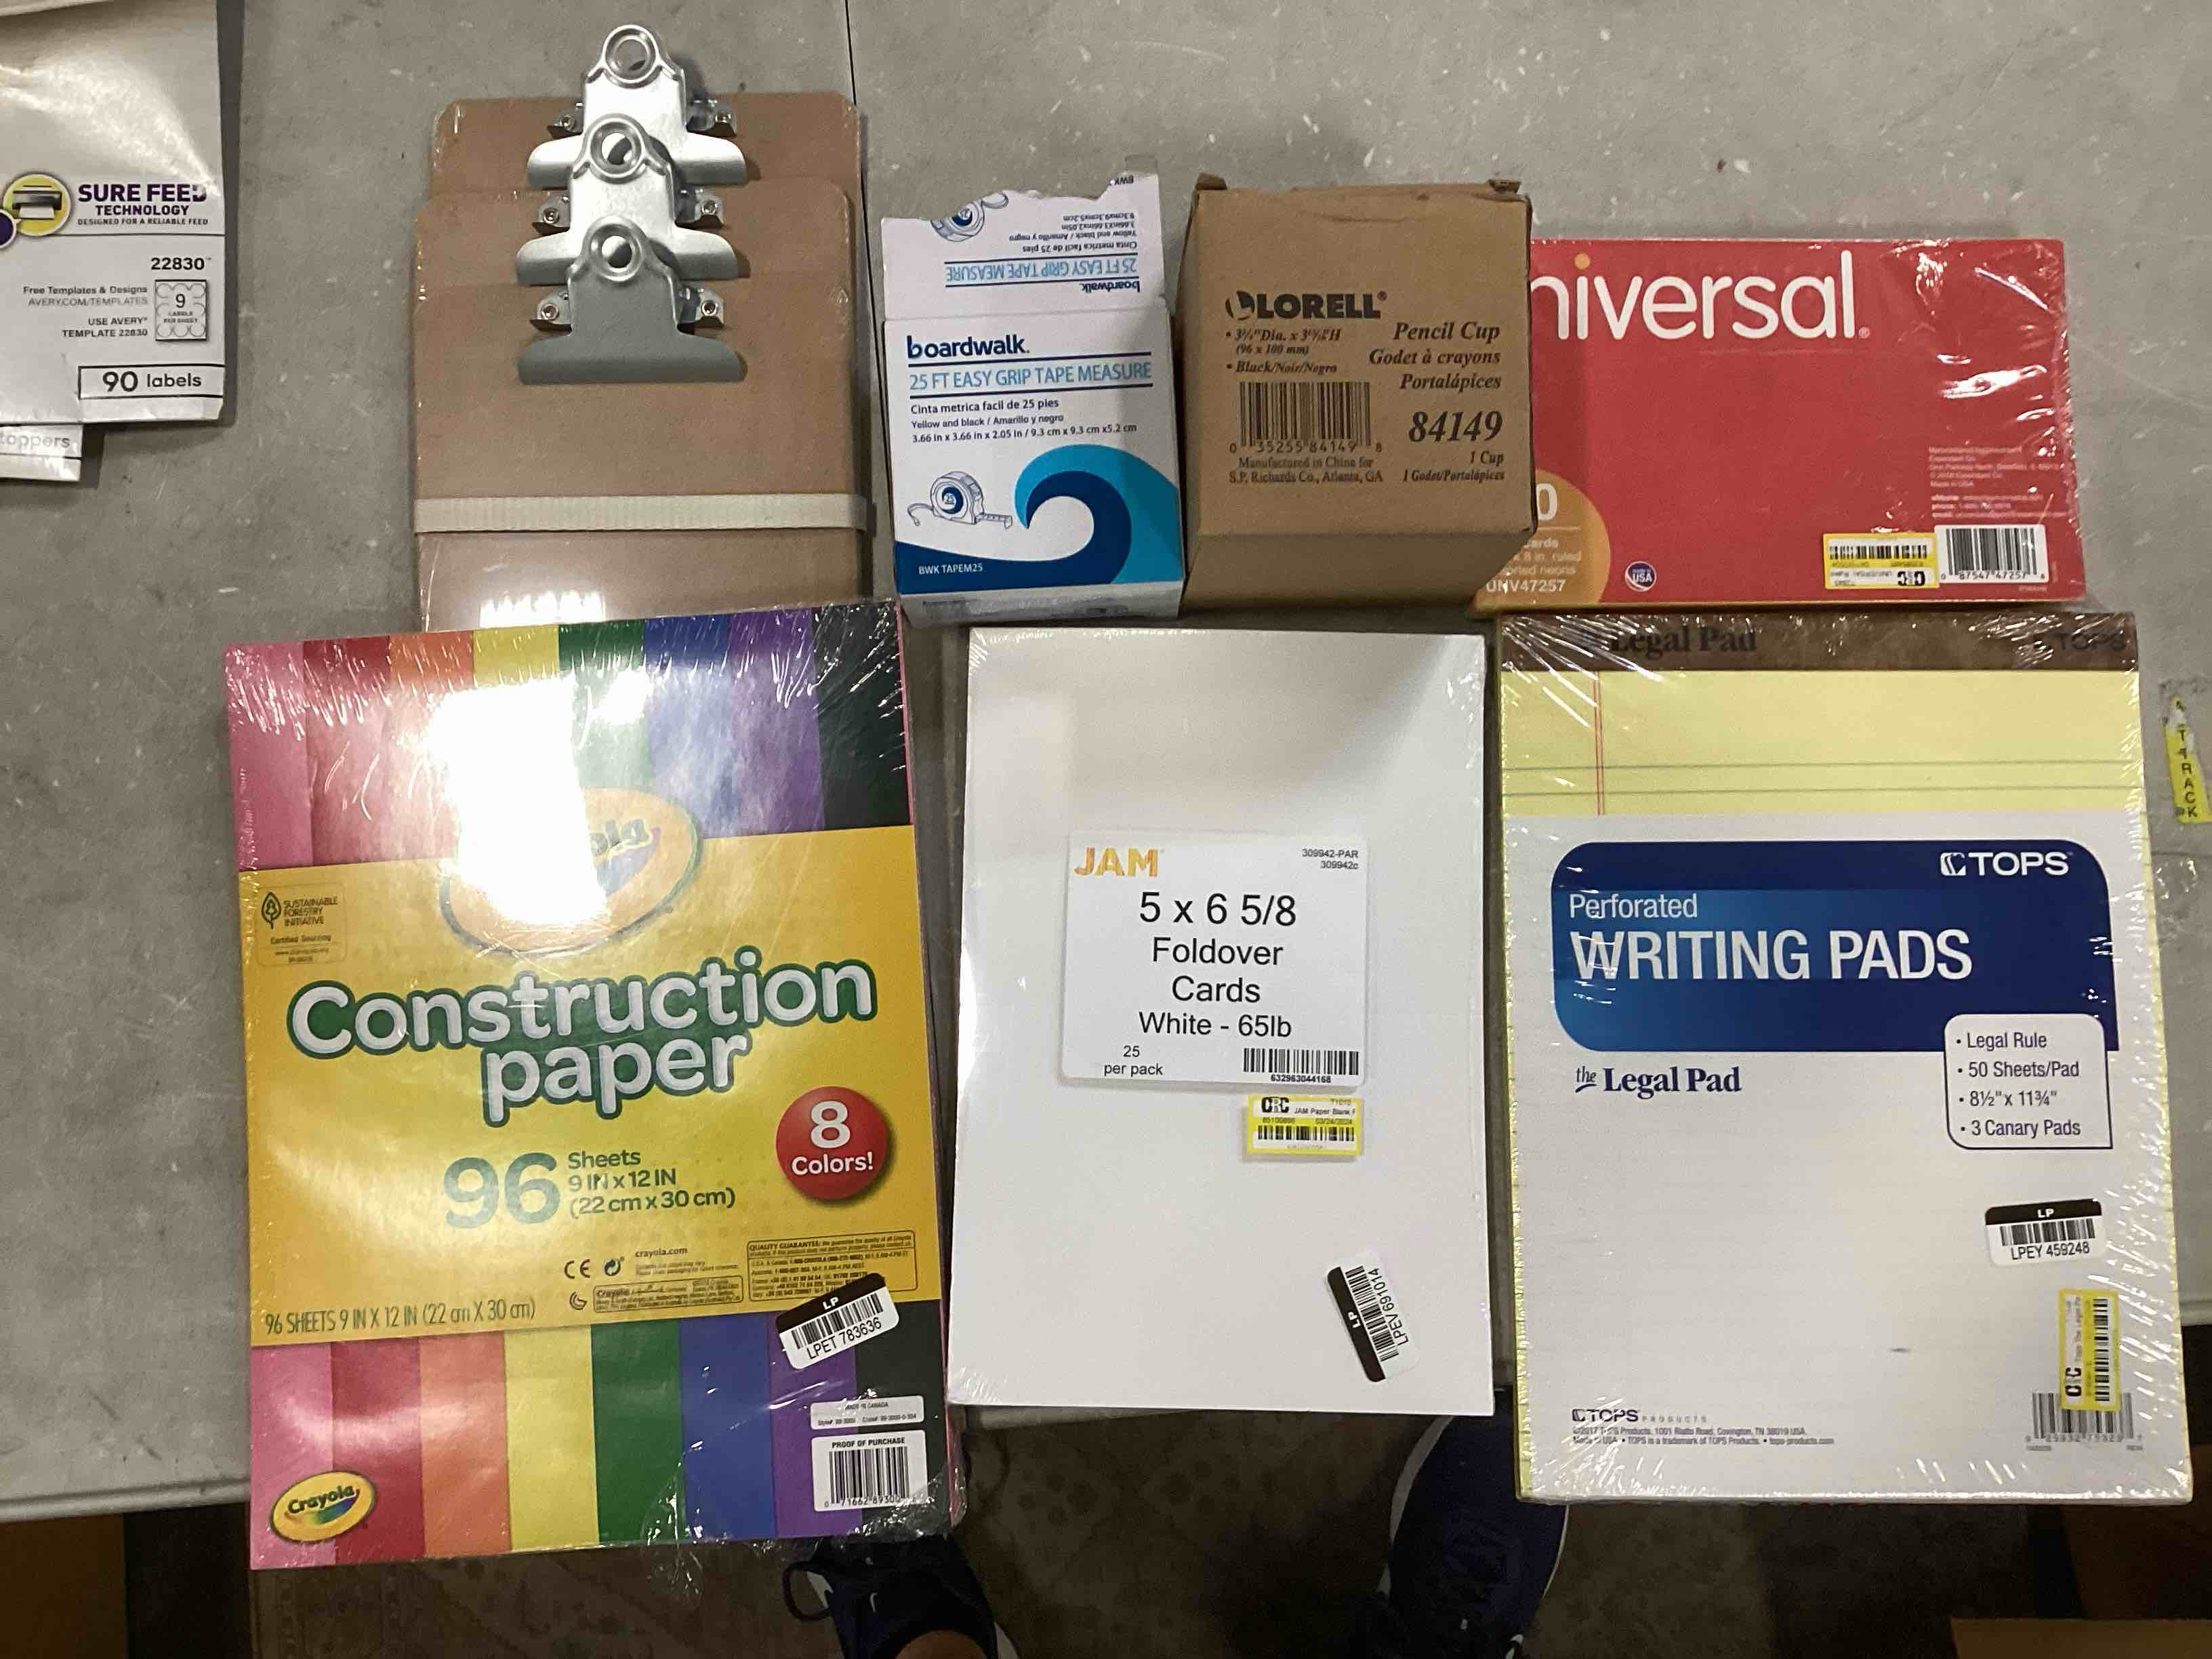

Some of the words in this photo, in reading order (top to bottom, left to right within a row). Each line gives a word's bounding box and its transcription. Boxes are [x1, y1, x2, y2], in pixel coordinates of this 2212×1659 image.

[78, 184, 141, 203] SURE
[95, 205, 189, 217] TECHNOLOGY
[150, 258, 205, 270] 22830
[946, 265, 1005, 281] MEASURE
[1007, 264, 1037, 279] TAPE
[1041, 262, 1069, 276] GRIP
[1071, 260, 1102, 276] EASY
[1105, 259, 1119, 274] FT
[1122, 258, 1136, 272] 25
[23, 286, 45, 294] Free
[48, 286, 98, 295] Templates
[110, 286, 148, 295] Designs
[1530, 250, 1856, 339] niversal
[175, 294, 186, 310] 9
[88, 317, 108, 325] USE
[62, 329, 117, 337] TEMPLATE
[119, 329, 148, 337] 22830
[1393, 322, 1454, 341] Pencil
[1460, 321, 1500, 344] Cup
[1369, 349, 1418, 365] Godet
[1422, 348, 1432, 365] à
[1436, 350, 1501, 367] crayons
[102, 371, 138, 392] 90
[146, 373, 202, 388] labels
[910, 373, 928, 390] 25
[932, 372, 949, 389] FT
[954, 370, 991, 388] EASY
[996, 368, 1031, 386] GRIP
[1035, 365, 1075, 384] TAPE
[1078, 362, 1151, 382] MEASURE
[1400, 373, 1501, 393] Portalápices
[911, 405, 938, 415] Cinta
[941, 402, 980, 413] metrica
[982, 401, 1004, 411] facil
[1006, 400, 1019, 409] de
[1022, 399, 1035, 409] 25
[1038, 398, 1059, 410] pies
[912, 419, 940, 429] Yellow
[943, 419, 958, 428] and
[961, 417, 985, 427] black
[993, 415, 1029, 425] Amarillo
[1031, 416, 1036, 425] y
[1038, 414, 1064, 424] negro
[1408, 411, 1502, 443] 84149
[1239, 457, 1310, 468] Manufactured
[1312, 458, 1322, 468] in
[1326, 457, 1355, 468] China
[1359, 457, 1373, 468] for
[1470, 452, 1475, 464] 1
[1479, 451, 1504, 467] Cup
[1229, 472, 1248, 483] S.P.
[1251, 471, 1296, 483] Richards
[1366, 471, 1382, 483] GA
[918, 566, 939, 575] BWK
[941, 563, 983, 573] TAPEM25
[1633, 573, 1652, 582] USA
[1610, 628, 1690, 659] Legal
[1700, 626, 1757, 651] Pad
[1074, 847, 1159, 877] JAM
[1302, 848, 1359, 859] 309942-PAR
[1320, 861, 1359, 869] 309942c
[1968, 852, 2069, 876] TOPS
[283, 897, 338, 908] SUSTAINABLE
[284, 907, 323, 916] FORESTRY
[1139, 892, 1161, 923] 5
[1174, 901, 1194, 923] x
[1206, 893, 1227, 924] 6
[1241, 894, 1296, 926] 5/8
[1569, 893, 1698, 920] Perforated
[285, 916, 324, 926] INITIATIVE
[1153, 936, 1284, 966] Foldover
[1571, 928, 1810, 981] WRITING
[1830, 928, 1973, 980] PADS
[1172, 975, 1261, 1003] Cards
[289, 947, 876, 1058] Construction
[1139, 1011, 1212, 1036] White
[1237, 1014, 1292, 1038] 65lb
[1967, 1031, 2008, 1051] Legal
[2013, 1031, 2048, 1049] Rule
[1123, 1046, 1141, 1058] 25
[486, 1031, 750, 1126] paper
[1104, 1063, 1127, 1076] per
[1130, 1063, 1163, 1077] pack
[1270, 1074, 1331, 1084] 632963044168
[1968, 1061, 1988, 1078] 50
[1992, 1060, 2080, 1079] Sheets/Pad
[1576, 1066, 1597, 1085] the
[1603, 1067, 1681, 1100] Legal
[1686, 1067, 1742, 1094] Pad
[808, 1101, 851, 1149] 8
[1971, 1121, 1981, 1136] 3
[1984, 1120, 2039, 1140] Canary
[2043, 1118, 2082, 1137] Pads
[567, 1149, 641, 1168] Sheets
[791, 1149, 874, 1176] Colors!
[443, 1151, 558, 1229] 96
[569, 1174, 582, 1192] 9
[587, 1172, 609, 1190] IN
[613, 1175, 624, 1188] x
[628, 1170, 651, 1189] 12
[655, 1169, 676, 1187] IN
[570, 1195, 606, 1218] (22
[609, 1197, 643, 1212] cm
[646, 1196, 658, 1210] x
[661, 1190, 690, 1209] 30
[693, 1187, 735, 1210] cm)
[2037, 1208, 2054, 1218] LP
[635, 1247, 688, 1258] crayola.com
[2011, 1243, 2042, 1260] LPEY
[2046, 1241, 2090, 1256] 459248
[1368, 1268, 1395, 1311] 691014
[823, 1296, 840, 1310] LP
[265, 1313, 283, 1335] 96
[286, 1310, 336, 1334] SHEETS
[339, 1311, 348, 1331] 9
[352, 1308, 367, 1330] IN
[370, 1308, 380, 1329] X
[385, 1307, 399, 1328] 12
[403, 1305, 417, 1326] IN
[422, 1302, 446, 1326] (22
[450, 1304, 470, 1324] cm
[474, 1300, 484, 1322] X
[487, 1299, 507, 1320] 30
[509, 1297, 535, 1320] cm)
[1348, 1311, 1361, 1328] LP
[806, 1338, 838, 1360] LPET
[840, 1317, 883, 1346] 783636
[1385, 1313, 1408, 1346] LPEV
[1586, 1410, 1638, 1422] TOPS
[832, 1440, 855, 1448] PROOF
[868, 1437, 905, 1446] PURCHASE
[288, 1485, 354, 1513] Crayola
